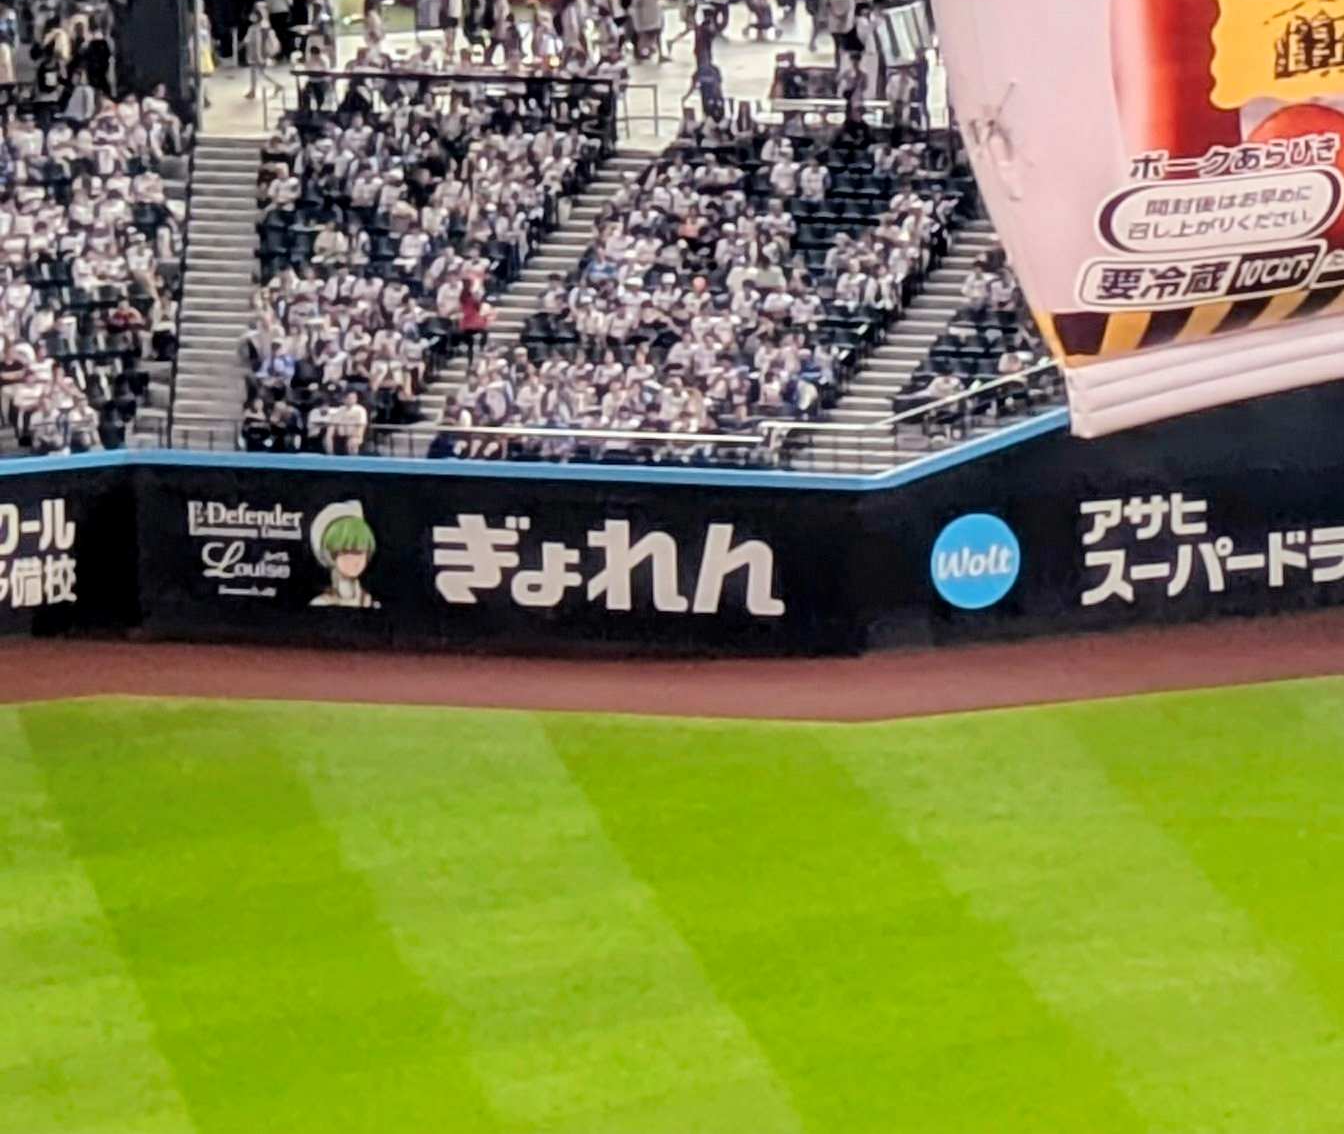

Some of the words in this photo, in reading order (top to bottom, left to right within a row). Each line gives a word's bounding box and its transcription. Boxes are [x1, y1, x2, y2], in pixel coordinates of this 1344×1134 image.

[1130, 137, 1339, 179] ポークあらびき
[1145, 185, 1313, 217] 開封後はお早めに
[1097, 265, 1228, 300] 要冷蔵
[1080, 493, 1209, 546] アサヒ
[432, 514, 786, 616] ぎょれん
[937, 544, 1013, 580] Wolt
